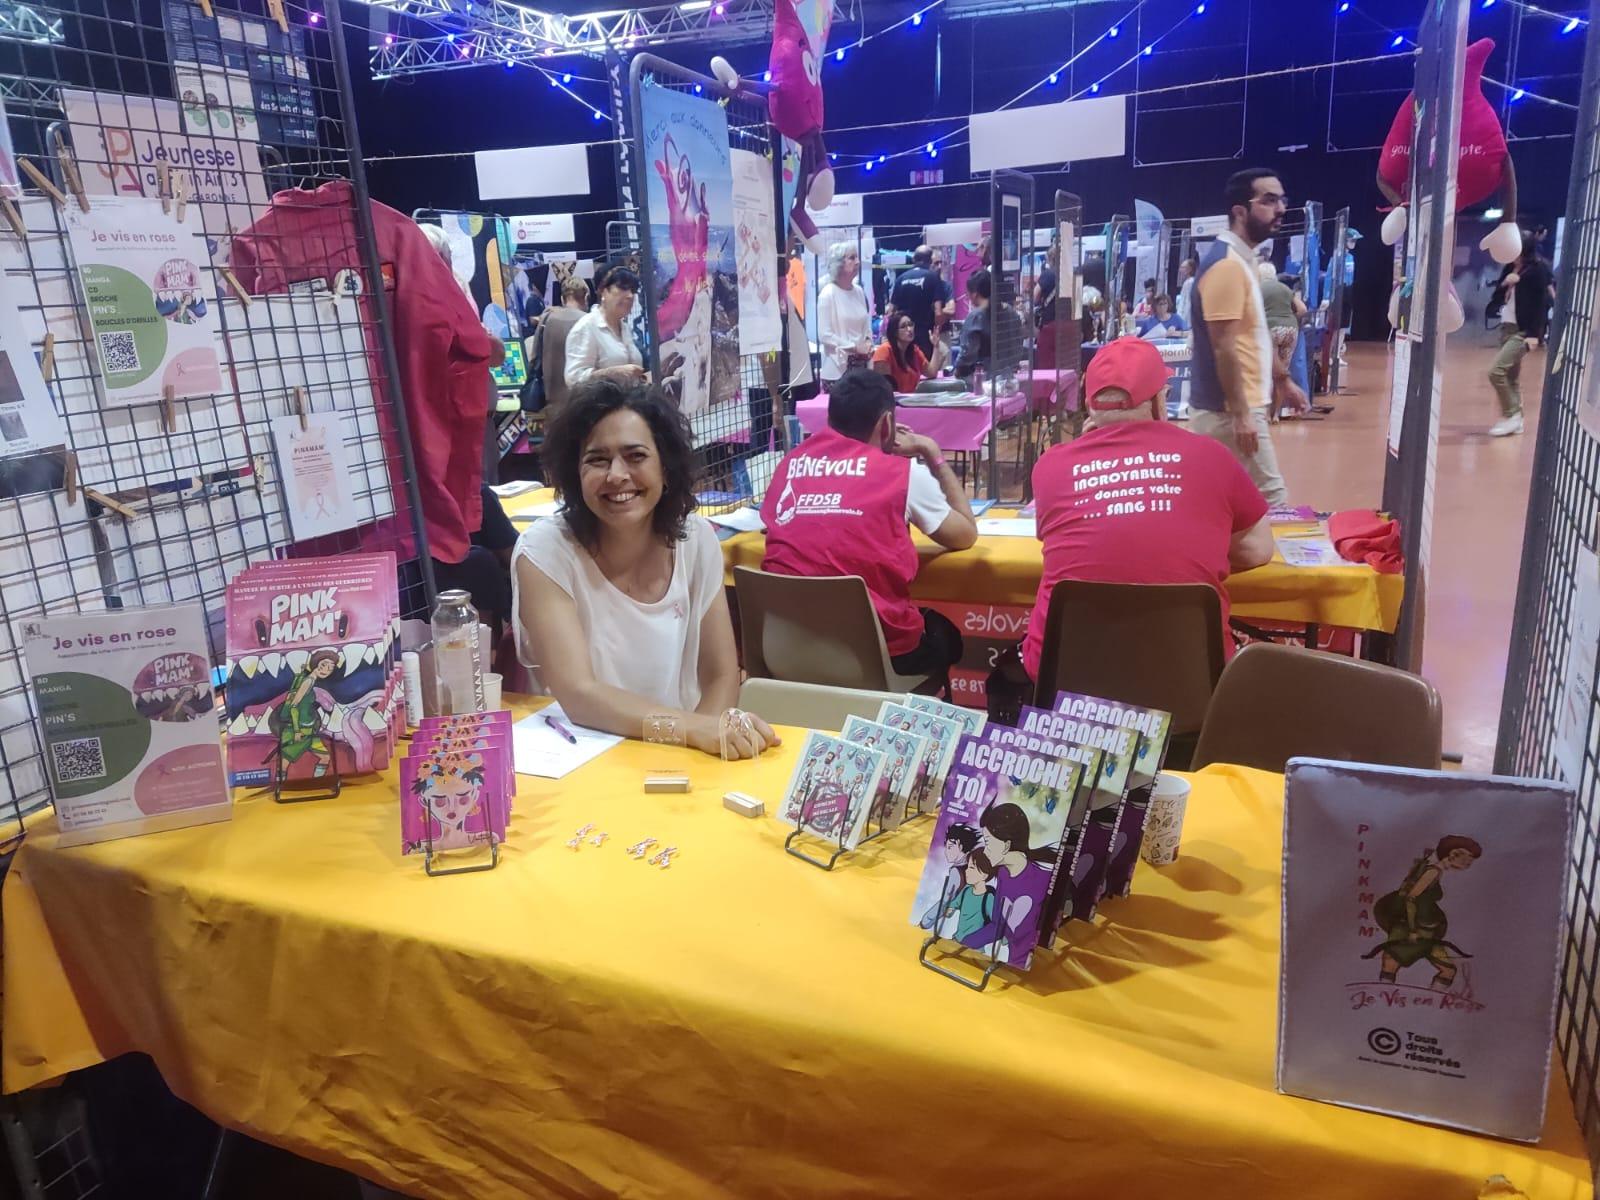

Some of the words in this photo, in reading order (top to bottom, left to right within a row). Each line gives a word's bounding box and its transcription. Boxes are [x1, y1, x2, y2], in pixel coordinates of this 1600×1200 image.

[142, 140, 235, 166] Jeunesse
[91, 230, 107, 242] Je
[111, 230, 130, 242] vis
[133, 232, 146, 242] en
[149, 232, 176, 242] rose
[786, 452, 868, 480] BÉNÉVOLE
[1072, 457, 1119, 477] Faites
[1123, 455, 1144, 466] un
[1148, 451, 1182, 464] truc
[1073, 467, 1182, 492] INCROYABLE...
[797, 493, 843, 506] FFDSB
[1094, 486, 1145, 501] donnez
[1149, 483, 1182, 495] votre
[1106, 499, 1146, 516] SANG
[271, 586, 339, 623] PINK
[53, 636, 73, 651] Je
[77, 633, 104, 647] vis
[109, 631, 132, 643] en
[137, 626, 177, 640] rose
[270, 609, 343, 648] MAM'
[154, 653, 191, 675] PINK
[155, 665, 195, 687] MAM'
[45, 713, 76, 725] PIN'S
[1058, 697, 1164, 739] ACCROCHE
[1023, 711, 1132, 757] ACCROCHE
[961, 741, 1074, 792] ACCROCHE
[954, 773, 988, 806] TOI
[1350, 990, 1376, 1011] Je
[1413, 996, 1433, 1006] en
[1405, 1042, 1443, 1056] droits
[1406, 1031, 1438, 1045] Tous
[1405, 1052, 1461, 1069] réservés
